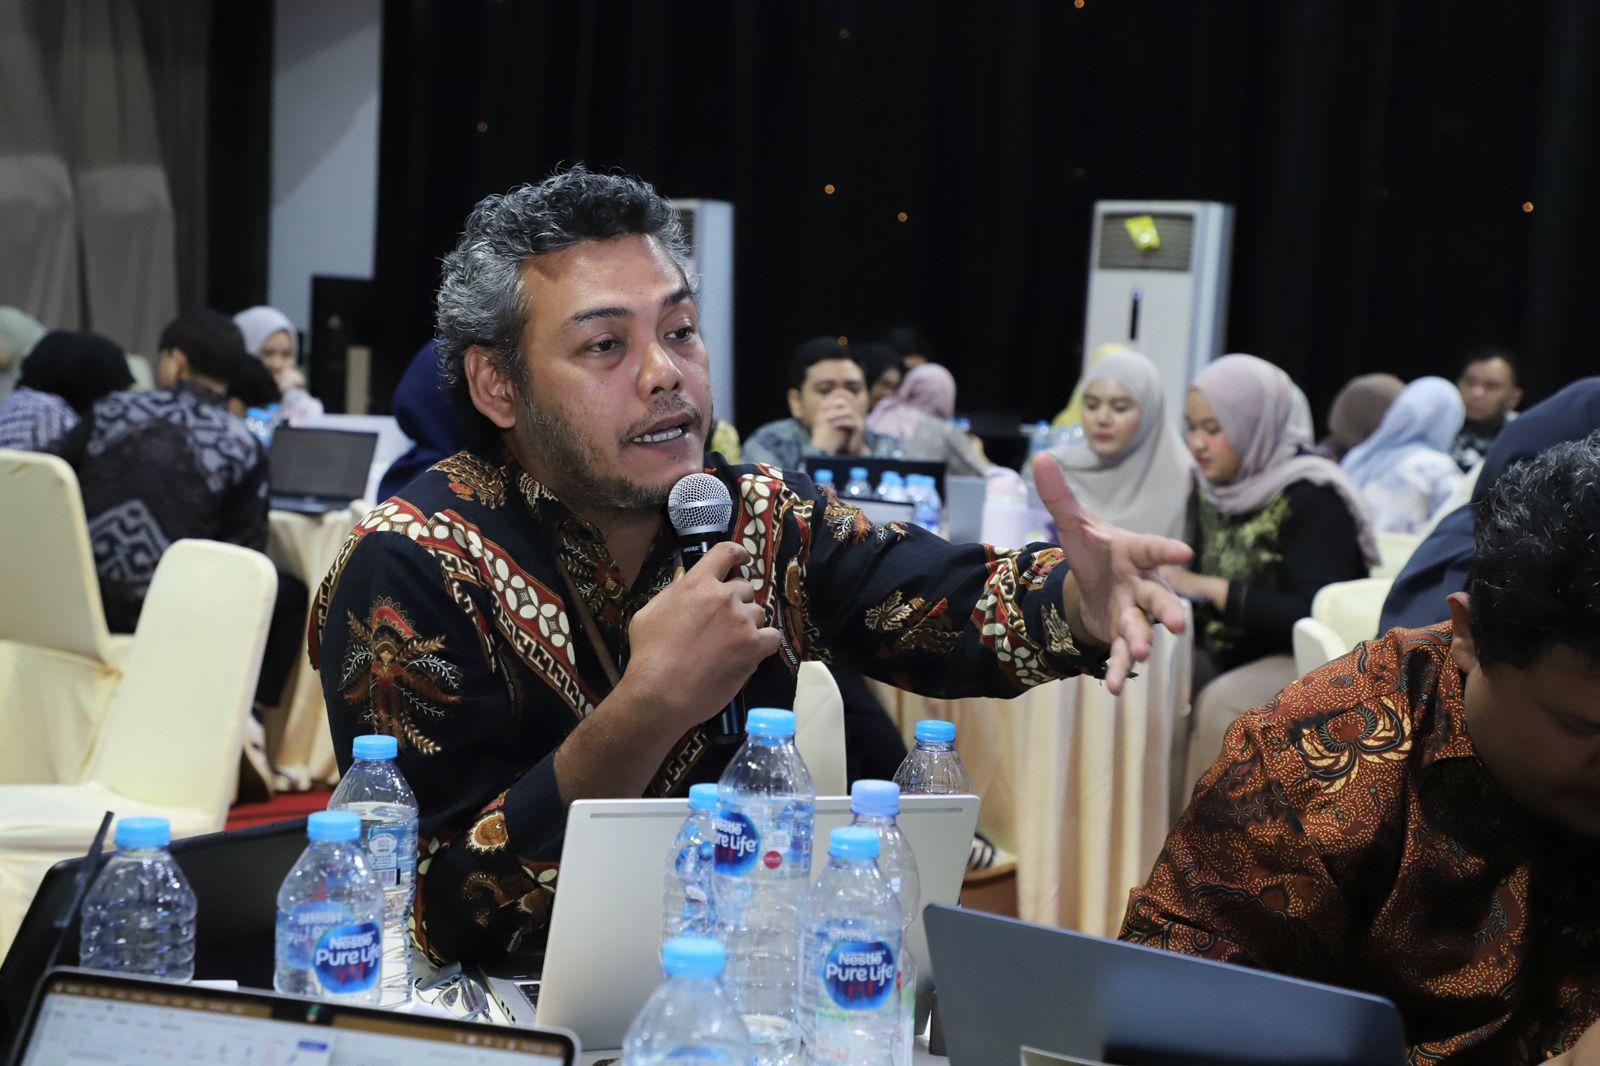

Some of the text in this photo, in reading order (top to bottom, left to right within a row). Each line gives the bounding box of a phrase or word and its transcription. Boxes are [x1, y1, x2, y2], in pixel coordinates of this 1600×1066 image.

[730, 834, 756, 857] Life
[316, 948, 360, 967] Pure
[826, 962, 893, 987] Pure Life
